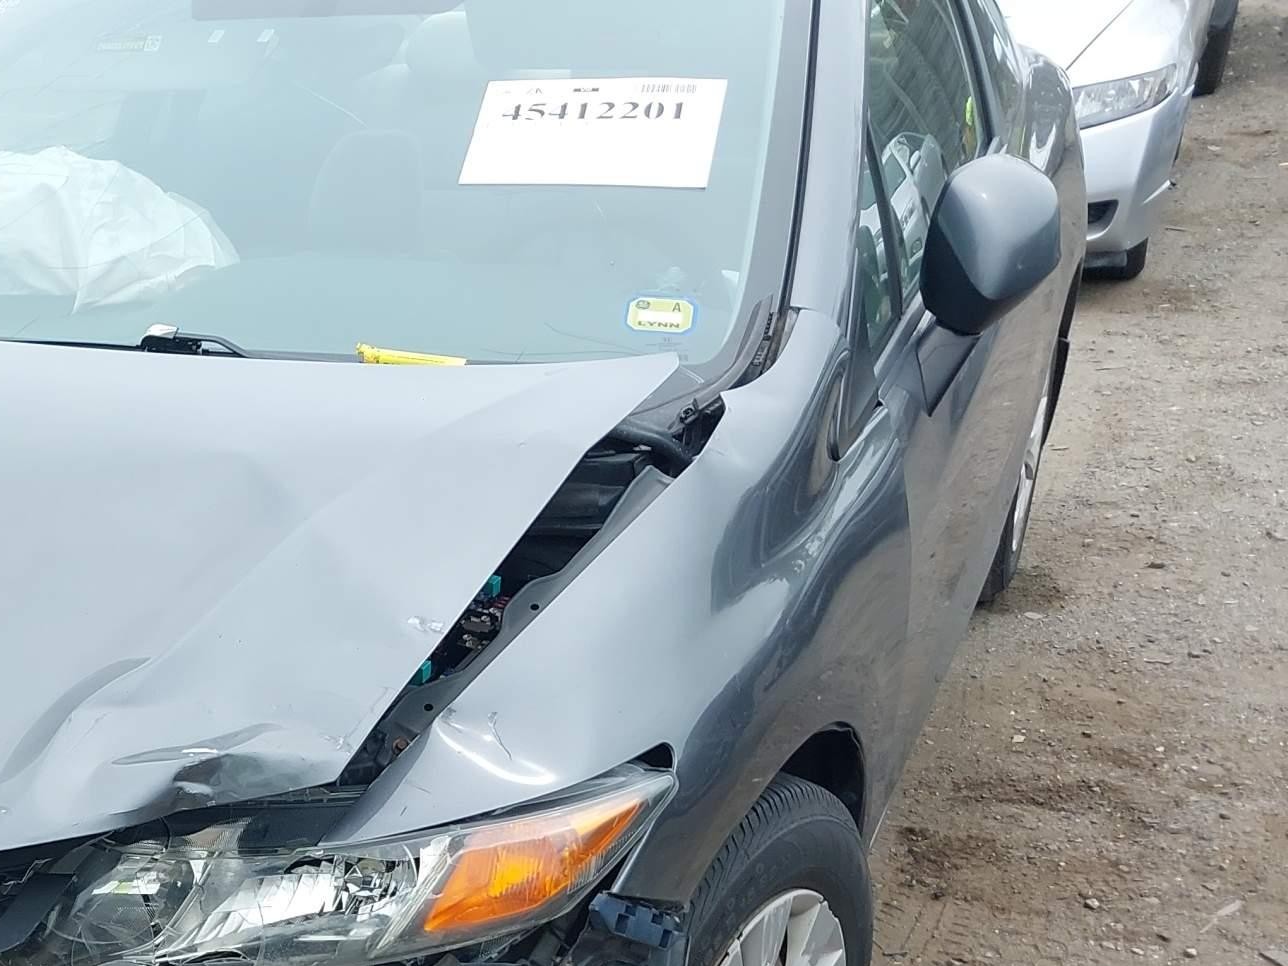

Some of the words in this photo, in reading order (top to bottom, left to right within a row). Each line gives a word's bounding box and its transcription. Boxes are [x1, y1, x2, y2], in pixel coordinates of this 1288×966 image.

[502, 101, 685, 120] 45412201
[672, 302, 682, 312] A
[637, 320, 680, 329] LYNN
